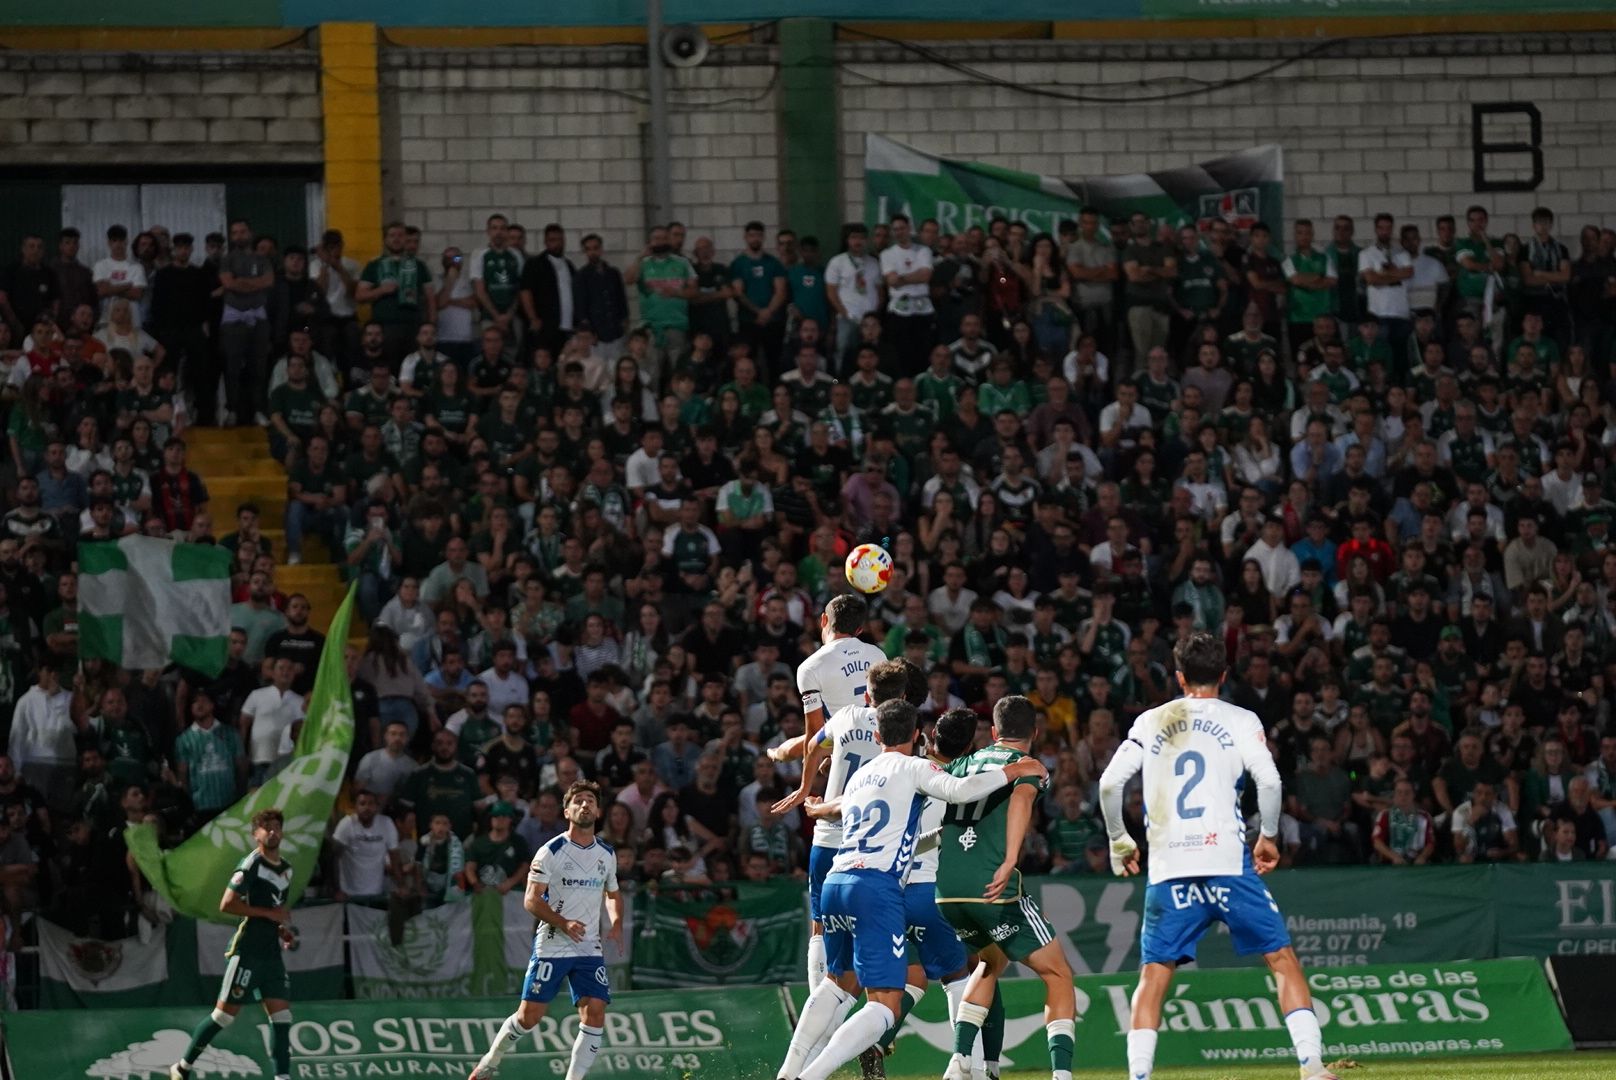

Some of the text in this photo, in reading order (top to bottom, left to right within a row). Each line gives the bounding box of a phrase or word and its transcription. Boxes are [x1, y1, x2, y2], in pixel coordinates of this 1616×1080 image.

[1472, 101, 1544, 193] B
[839, 728, 873, 747] AITOR
[1151, 719, 1235, 756] DAVID RGUEZ
[1174, 750, 1206, 820] 2
[838, 799, 891, 856] 22
[1286, 912, 1417, 932] Alemania, 18
[1295, 934, 1383, 951] 22 07 07
[236, 967, 252, 987] 18
[536, 961, 553, 982] 10
[1309, 973, 1381, 991] Casa
[1388, 970, 1427, 988] de
[1433, 968, 1478, 985] las
[636, 1055, 664, 1070] 02
